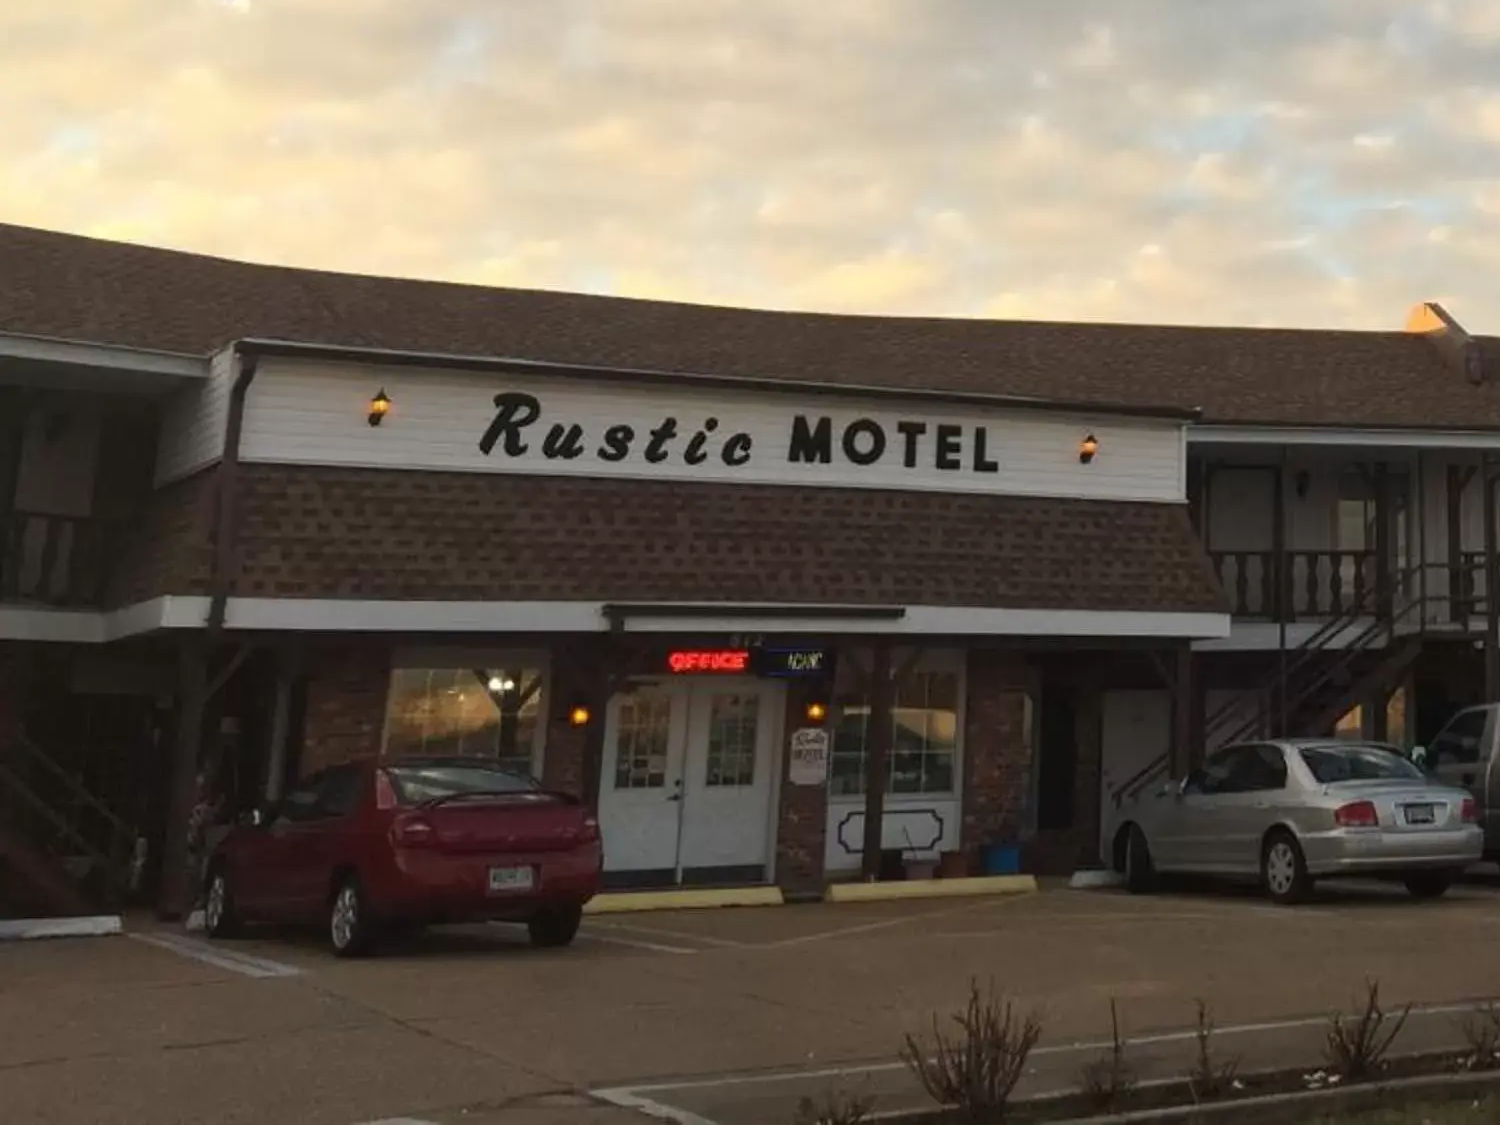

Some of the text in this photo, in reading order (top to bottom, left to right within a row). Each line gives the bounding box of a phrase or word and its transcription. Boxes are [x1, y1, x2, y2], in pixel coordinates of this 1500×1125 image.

[479, 391, 999, 473] Rustic MOTEL
[669, 651, 749, 672] OFFICE
